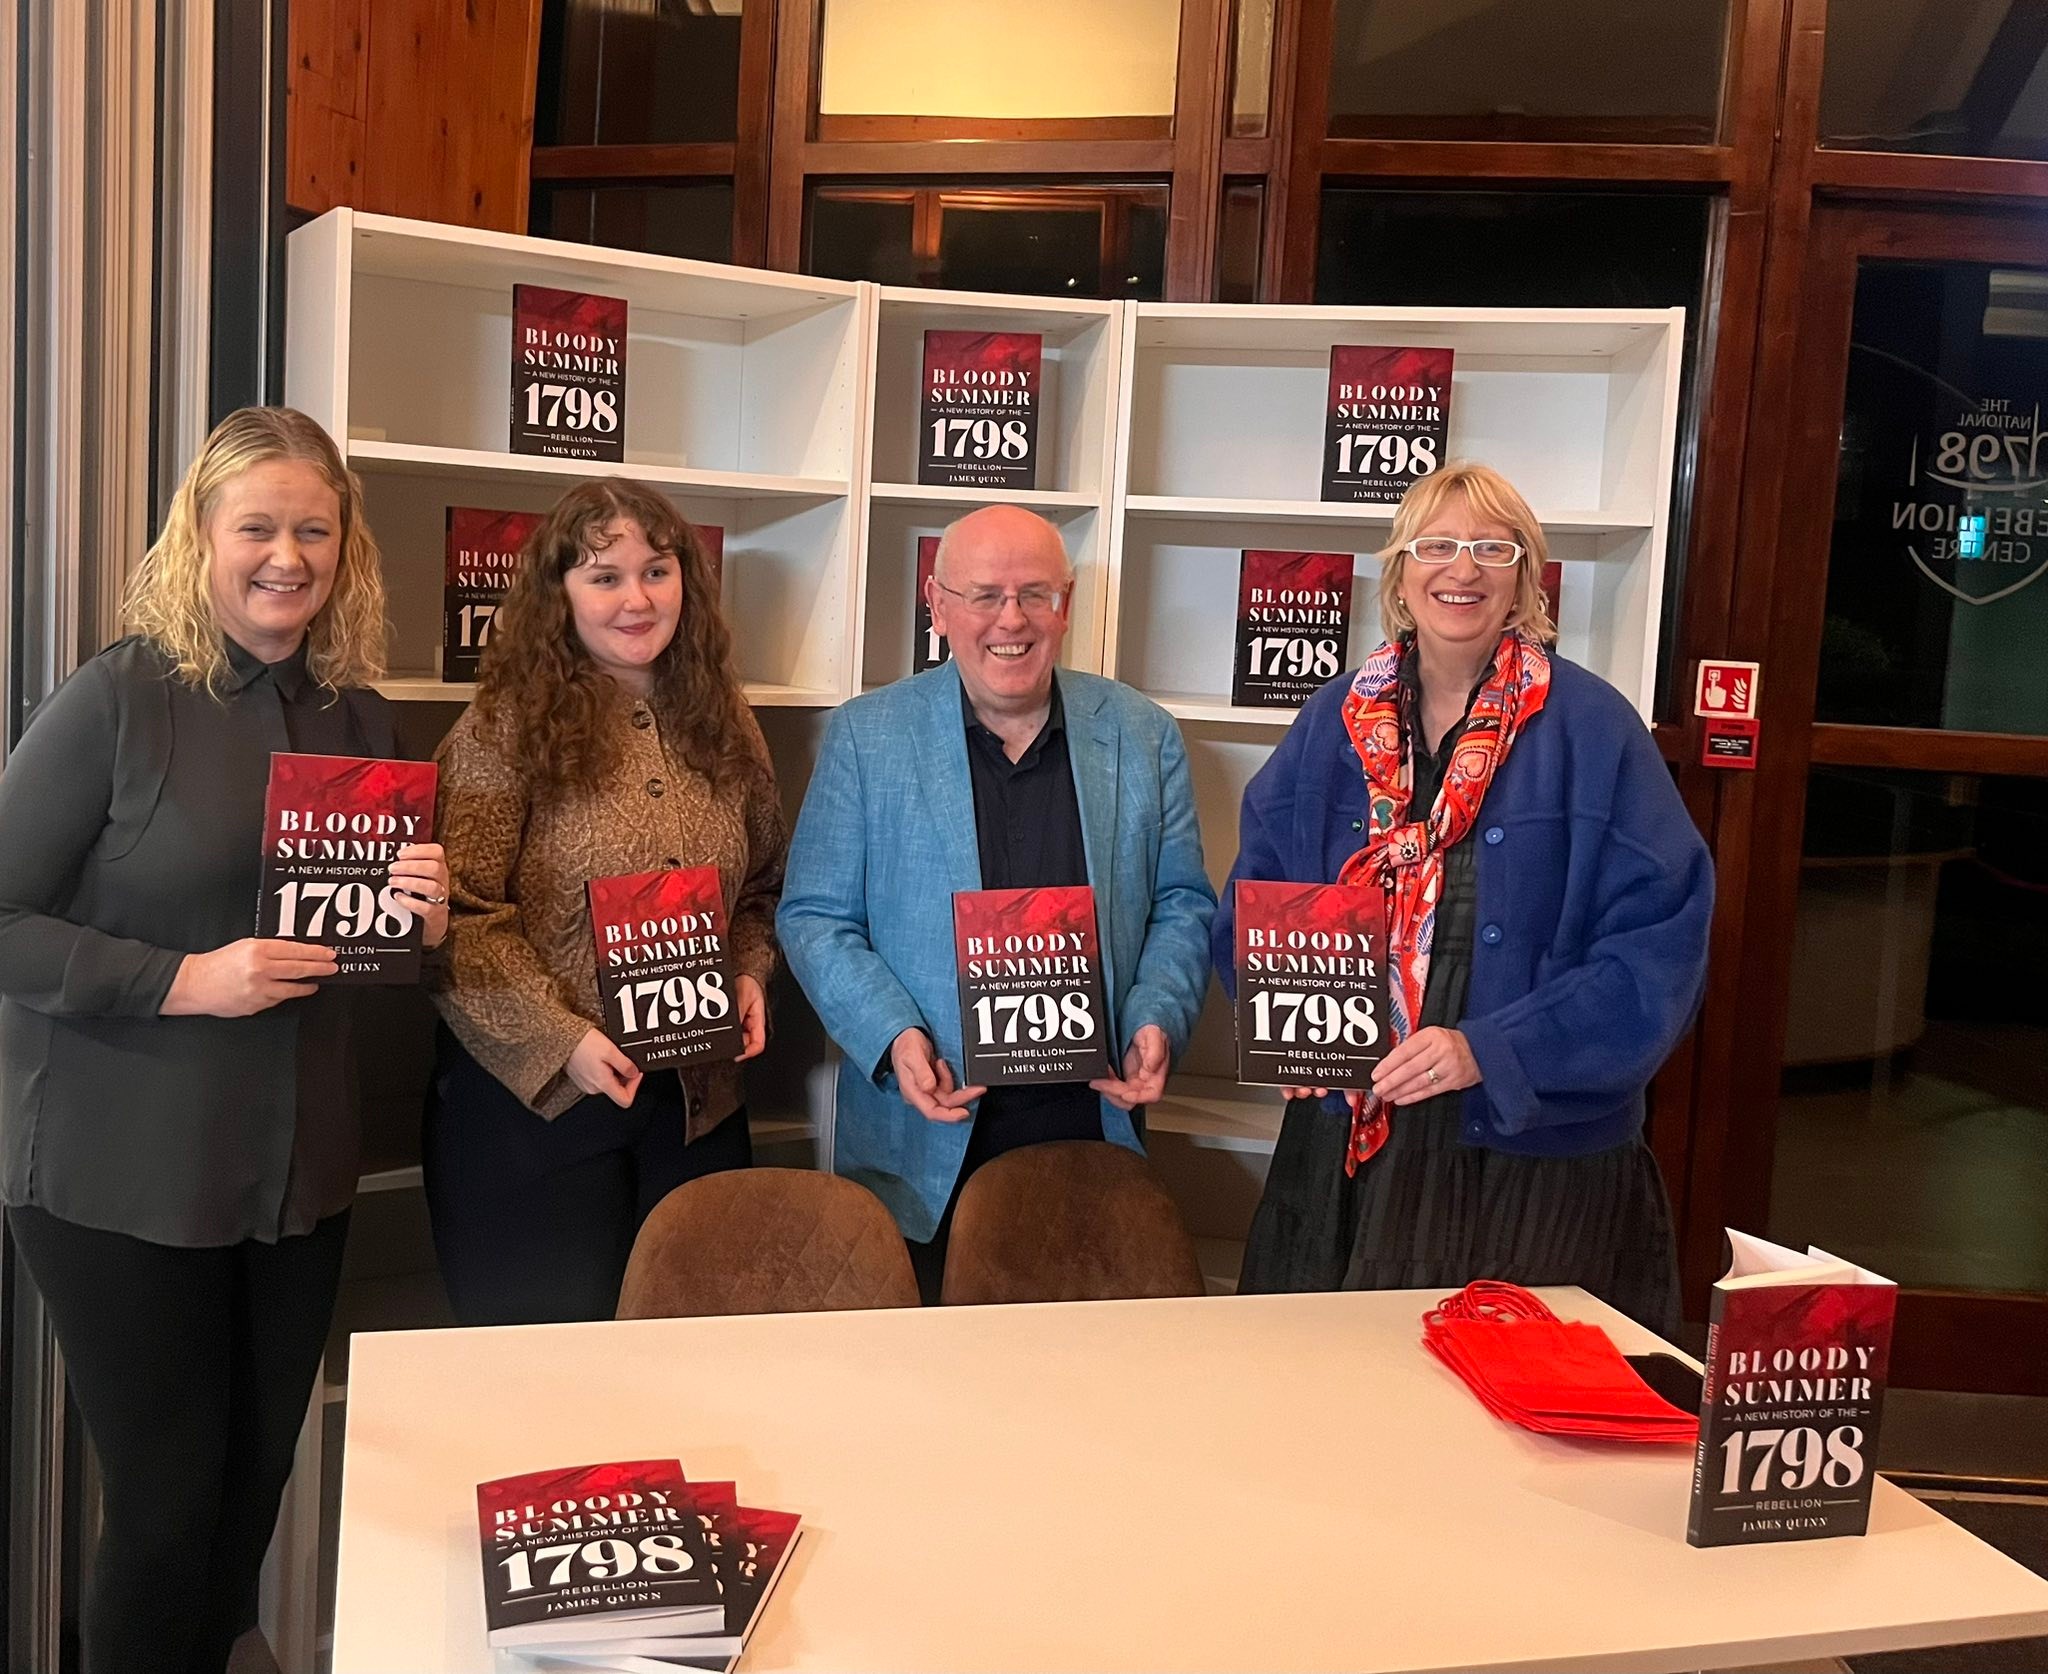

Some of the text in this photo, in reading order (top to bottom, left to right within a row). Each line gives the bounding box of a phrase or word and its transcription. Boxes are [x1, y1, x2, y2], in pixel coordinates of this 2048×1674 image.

[526, 327, 618, 355] BLOODY
[524, 349, 618, 376] SUMMER
[539, 371, 556, 379] NEW
[558, 373, 585, 382] HISTORY
[933, 369, 1031, 386] BLOODY
[931, 388, 1030, 405] SUMMER
[1340, 384, 1441, 401] BLOODY
[524, 383, 618, 432] 1798
[1337, 404, 1440, 421] SUMMER
[551, 433, 593, 443] REBELLION
[930, 418, 1028, 460] 1798
[543, 446, 597, 456] JAMES QUINN
[1336, 434, 1437, 475] 1798
[1362, 479, 1408, 487] REBELLION
[1353, 491, 1381, 499] JAMES
[459, 550, 521, 569] BLOO
[458, 571, 516, 589] SUMM
[1251, 588, 1343, 606] BLOODY
[458, 604, 504, 648] 17
[1249, 608, 1342, 625] SUMMER
[1248, 637, 1339, 678] 1798
[1271, 681, 1314, 689] REBELLION
[280, 810, 421, 835] BLOODY
[299, 866, 323, 874] NEW
[326, 867, 367, 875] HISTORY
[274, 882, 413, 937] 1798
[605, 912, 714, 943] BLOODY
[967, 933, 1085, 956] BLOODY
[1248, 928, 1374, 953] BLOODY
[328, 946, 375, 955] ELLION
[608, 935, 720, 967] SUMMER
[341, 963, 380, 974] QUINN
[629, 968, 648, 977] NEW
[650, 964, 683, 974] HISTORY
[699, 958, 714, 966] THE
[968, 956, 1089, 979] SUMMER
[1247, 953, 1376, 977] SUMMER
[989, 982, 1009, 990] NEW
[1012, 980, 1047, 989] HISTORY
[1268, 978, 1290, 986] NEW
[1293, 979, 1330, 988] HISTORY
[1349, 982, 1366, 990] THE
[614, 971, 729, 1034] 1798
[972, 992, 1095, 1045] 1798
[1249, 991, 1379, 1046] 1798
[654, 1029, 704, 1044] REBELLION
[647, 1042, 712, 1062] JAMES QUINN
[1011, 1048, 1065, 1057] REBELLION
[1288, 1051, 1345, 1061] REBELLION
[1003, 1063, 1073, 1074] JAMES QUINN
[1278, 1065, 1352, 1077] JAMES QUINN
[1729, 1347, 1875, 1376] BLOODY
[1724, 1377, 1871, 1407] SUMMER
[1734, 1408, 1857, 1422] A NEW HISTORY OF THE
[1720, 1425, 1864, 1494] 1798
[495, 1490, 671, 1525] BLOODY
[1756, 1499, 1821, 1511] REBELLION
[496, 1507, 681, 1542] SUMMER
[1742, 1517, 1827, 1532] JAMES QUINN
[526, 1536, 556, 1546] NEW
[562, 1529, 617, 1541] HISTORY
[643, 1524, 668, 1533] THE
[498, 1535, 694, 1594] 1798
[561, 1581, 648, 1596] REBELLION
[547, 1592, 662, 1613] JAMES QUINN
